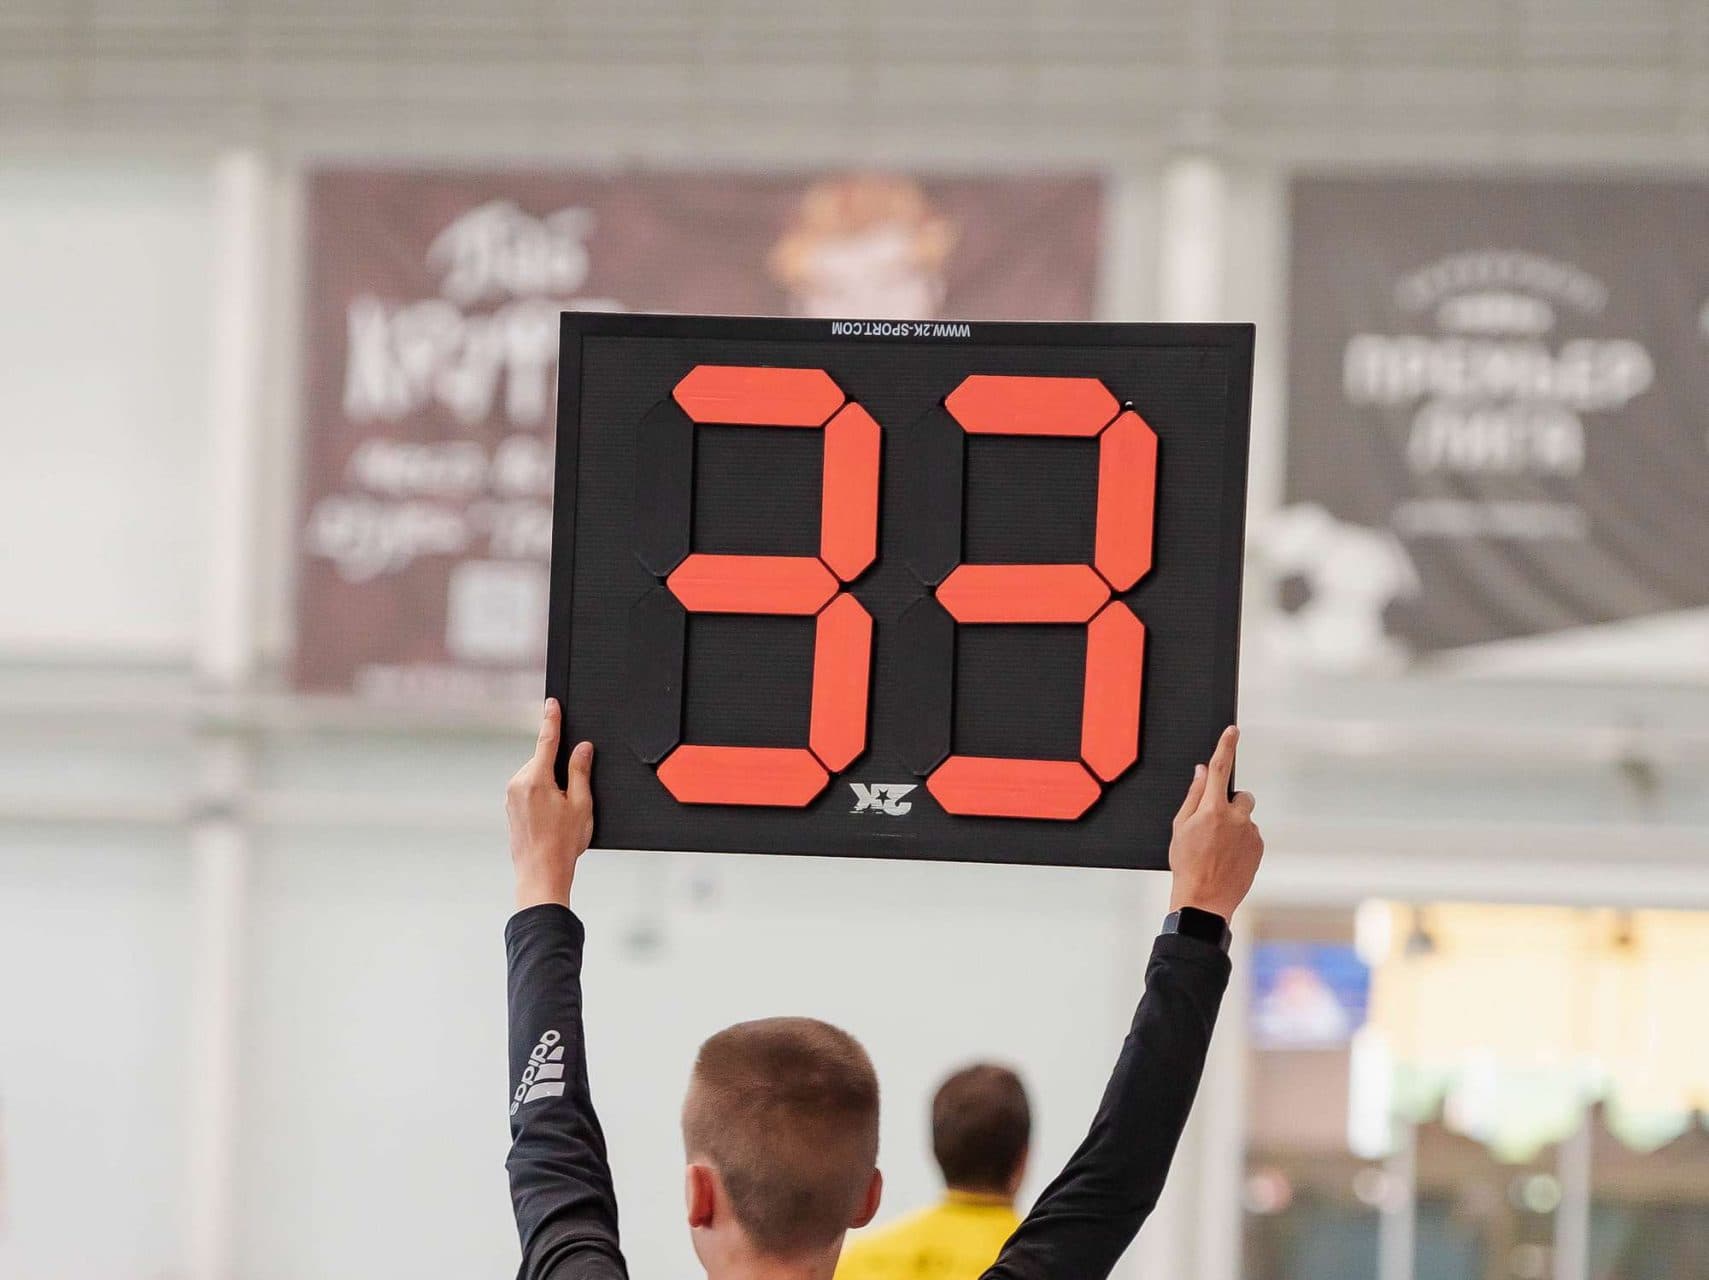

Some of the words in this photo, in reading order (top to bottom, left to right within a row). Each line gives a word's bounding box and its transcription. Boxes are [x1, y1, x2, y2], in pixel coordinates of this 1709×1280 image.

[832, 322, 971, 337] WWW.2K-SPORT.COM
[656, 365, 1158, 819] 33
[510, 1030, 561, 1116] adidas
